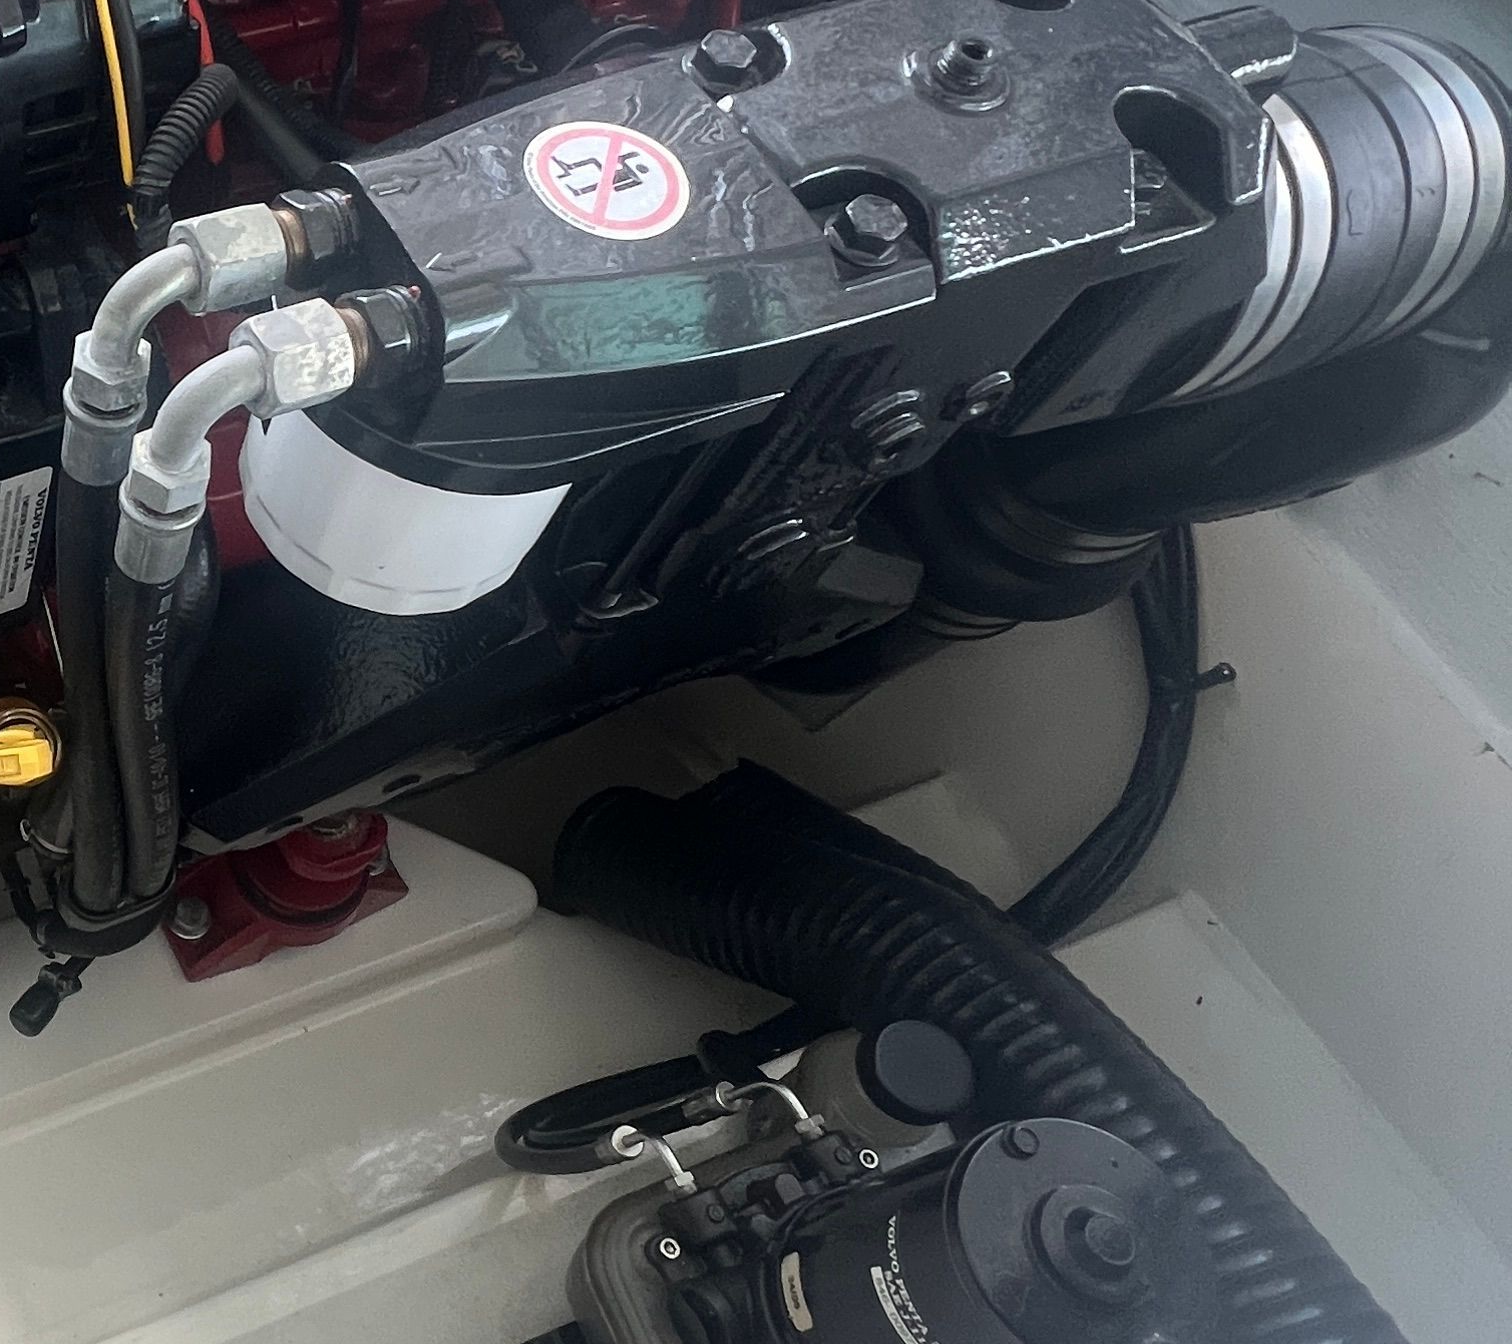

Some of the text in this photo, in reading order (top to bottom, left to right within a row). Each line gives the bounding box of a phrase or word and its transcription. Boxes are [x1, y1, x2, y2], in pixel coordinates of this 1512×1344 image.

[32, 487, 47, 533] VOLVO
[888, 1216, 928, 1335] VOLVO PENTA
